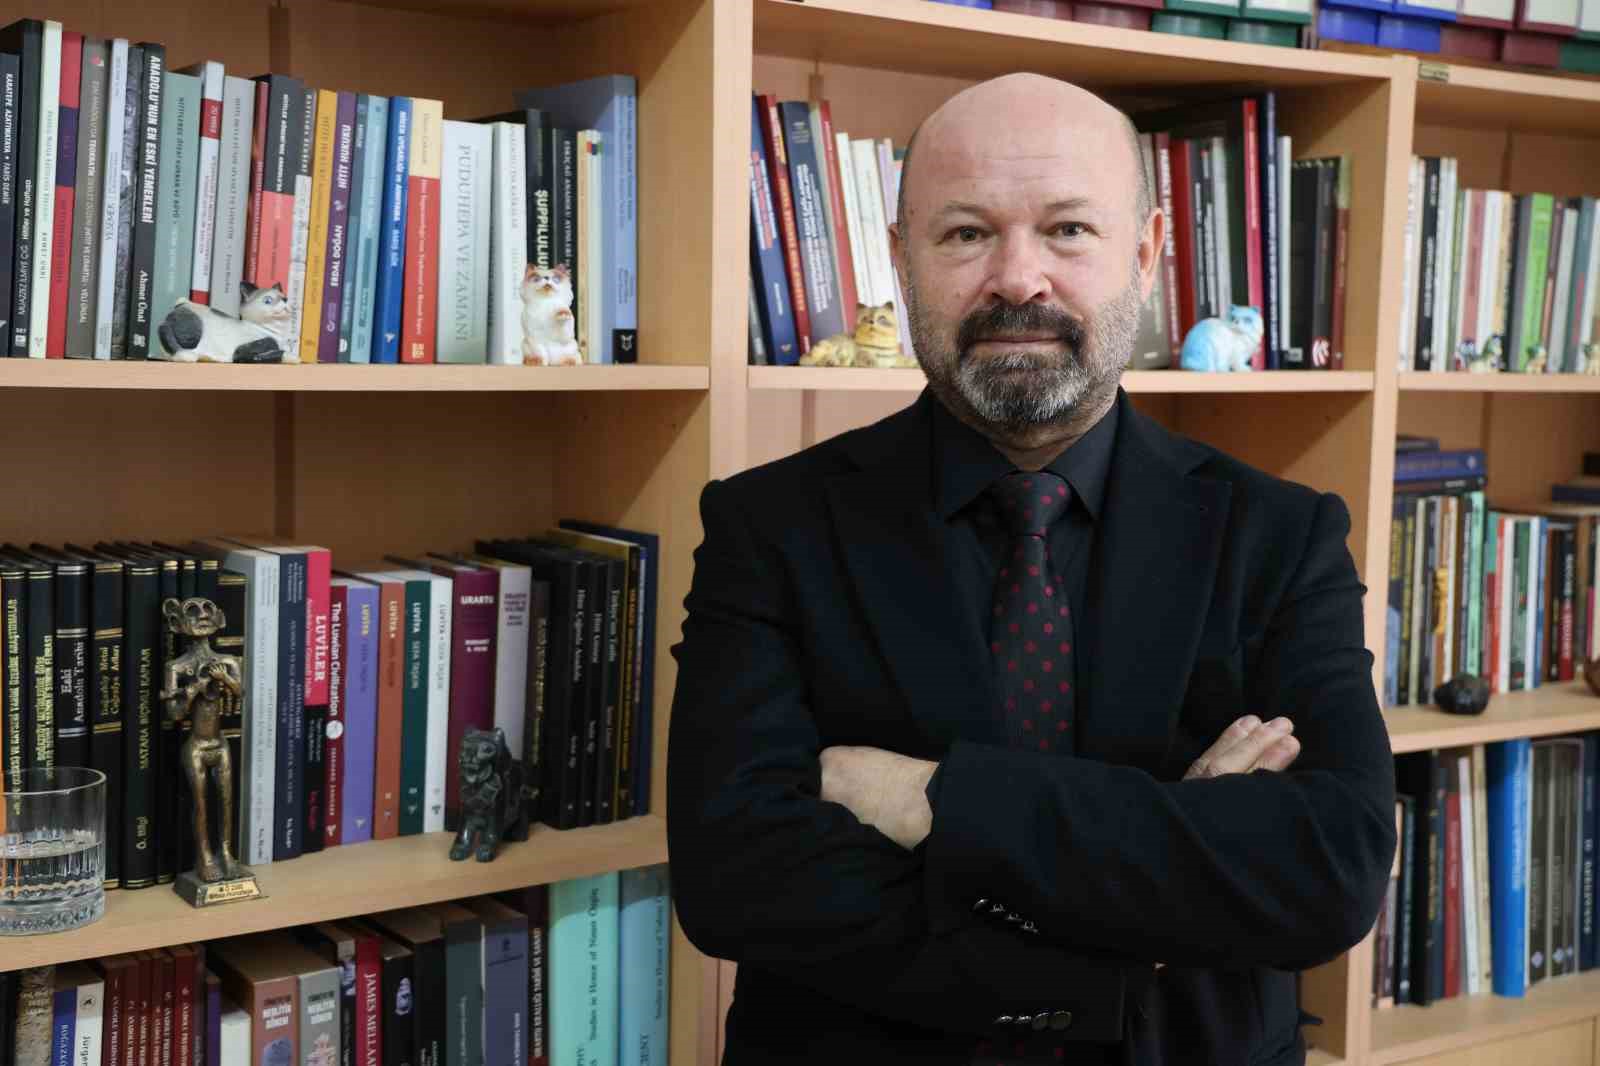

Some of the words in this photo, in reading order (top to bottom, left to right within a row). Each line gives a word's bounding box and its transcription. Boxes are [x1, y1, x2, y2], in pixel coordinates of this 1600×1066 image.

[4, 73, 13, 107] KARATEPE
[147, 56, 161, 125] ANADOLU'NUN
[146, 126, 158, 140] EN
[340, 124, 352, 162] HUKUKU
[87, 139, 98, 177] TEOKRATİK
[145, 142, 158, 165] ESKİ
[337, 164, 348, 189] HİTİT
[456, 145, 472, 238] PUDUHEPA
[140, 167, 155, 224] YEMEKLERİ
[331, 225, 343, 259] DOĞAN
[456, 244, 470, 265] VE
[138, 269, 149, 300] Ahmet
[330, 261, 341, 287] ERDAL
[17, 284, 27, 316] MUAZZEZ
[136, 302, 148, 323] Ünal
[455, 271, 470, 341] ZAMANI
[331, 602, 342, 622] The
[389, 600, 400, 632] LUVİYA
[460, 595, 494, 605] URARTU
[411, 601, 422, 634] LUVİYA
[438, 604, 448, 635] LUVİYA
[110, 644, 120, 671] Adları
[314, 614, 329, 682] LUVİLER
[330, 623, 341, 660] Luwian
[411, 640, 420, 660] SEFA
[73, 641, 84, 676] Tarihi
[140, 648, 151, 687] KAPLAR
[60, 668, 72, 694] Eski
[330, 661, 341, 716] Civilization
[73, 678, 84, 722] Anadolu
[138, 728, 150, 769] MATARA
[588, 950, 598, 961] of
[363, 973, 377, 1012] JAMES
[588, 964, 598, 993] Honor
[589, 996, 598, 1006] in
[588, 1009, 598, 1041] Studies
